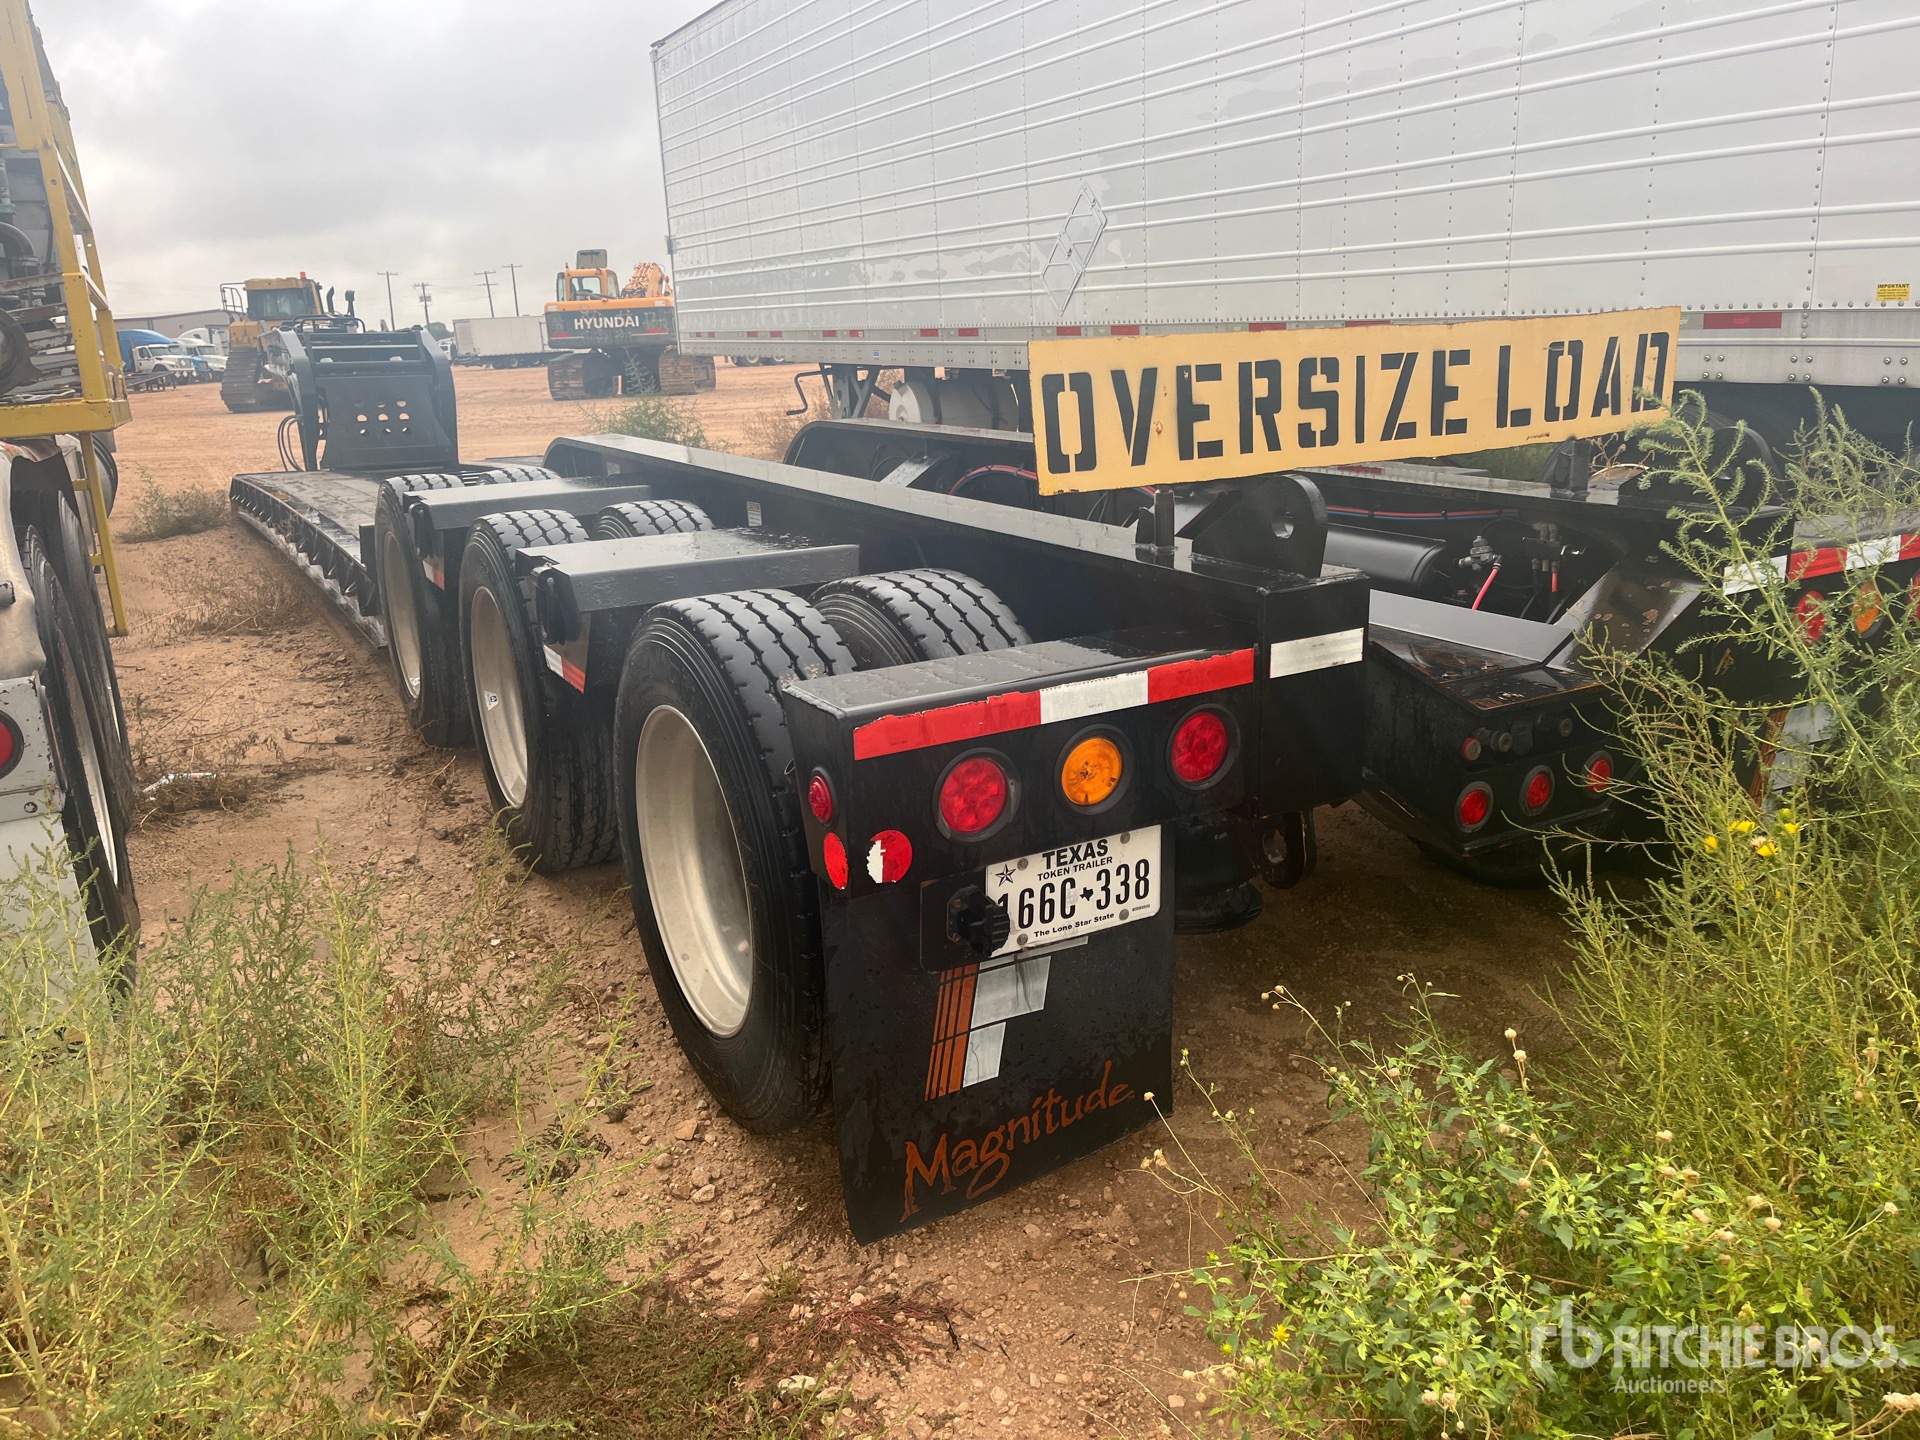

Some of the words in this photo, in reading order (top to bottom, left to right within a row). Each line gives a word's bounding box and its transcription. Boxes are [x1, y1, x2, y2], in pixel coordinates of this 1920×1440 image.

[574, 315, 640, 330] HYUNDAI
[1041, 349, 1471, 474] OVERSIZE
[1496, 331, 1669, 429] LOAD
[1042, 839, 1108, 869] TEXAS
[1037, 867, 1071, 881] TOKEN
[1073, 856, 1113, 873] TRAILER
[1034, 929, 1050, 938] The
[1052, 923, 1073, 934] Lone
[1075, 918, 1092, 928] Star
[1093, 912, 1115, 924] State
[900, 1059, 1135, 1224] Magnitude
